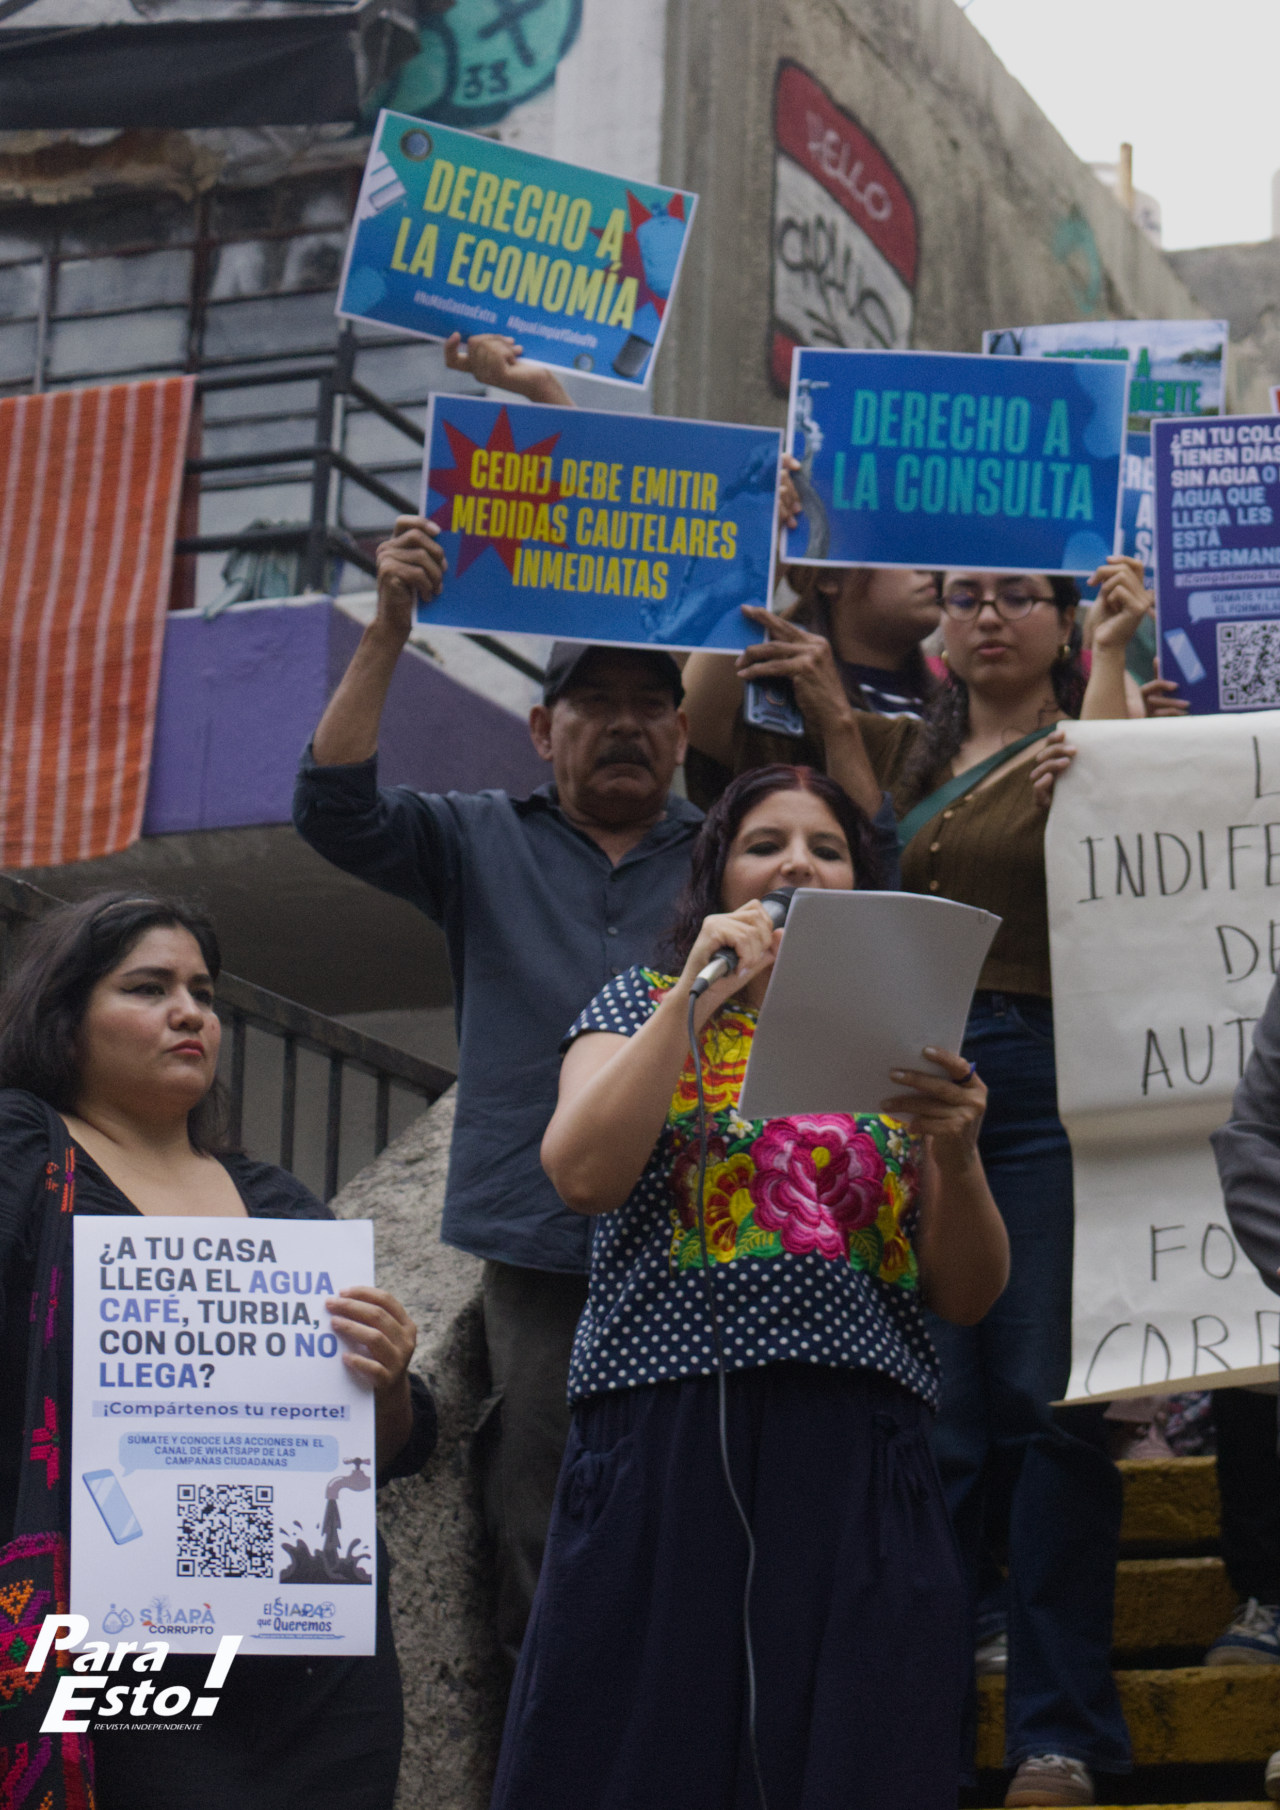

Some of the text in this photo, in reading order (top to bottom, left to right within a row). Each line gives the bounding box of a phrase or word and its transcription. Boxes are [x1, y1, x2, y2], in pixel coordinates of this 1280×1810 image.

[423, 157, 627, 262] DERECHO A
[390, 216, 640, 331] LA ECONOMÍA
[850, 388, 1071, 457] DERECHO A
[1171, 428, 1206, 450] ¿EN
[1208, 426, 1236, 445] TU
[1171, 446, 1240, 467] TIENEN
[559, 458, 623, 501] DEBE
[630, 464, 719, 511] EMITIR
[832, 450, 1094, 521] LA CONSULTA
[1171, 468, 1204, 488] SIN
[1206, 466, 1260, 487] AGUA
[1262, 465, 1278, 484] O
[1171, 486, 1267, 508] AGUA QUE
[450, 494, 738, 560] MEDIDAS CAUTELARES
[1171, 506, 1274, 529] LLEGA LES
[1172, 525, 1222, 550] ESTÁ
[512, 547, 669, 600] INMEDIATAS
[99, 1236, 278, 1266] ¿A TU CASA
[100, 1266, 334, 1295] LLEGA EL AGUA
[99, 1294, 320, 1330] CAFÉ, TURBIA,
[99, 1329, 338, 1358] CON OLOR O NO
[99, 1362, 215, 1388] LLEGA?
[103, 1401, 345, 1420] ¡Compártenos tu reporte!
[127, 1434, 324, 1447] SÚMATE Y CONOCE LAS ACCIONES EN EL
[154, 1446, 296, 1457] CANAL DE WHATSAPP DE LAS
[165, 1455, 288, 1467] CAMPAÑAS CIUDADANAS
[263, 1603, 272, 1615] El
[149, 1625, 214, 1635] CORRUPTO
[257, 1617, 332, 1632] que Queremos
